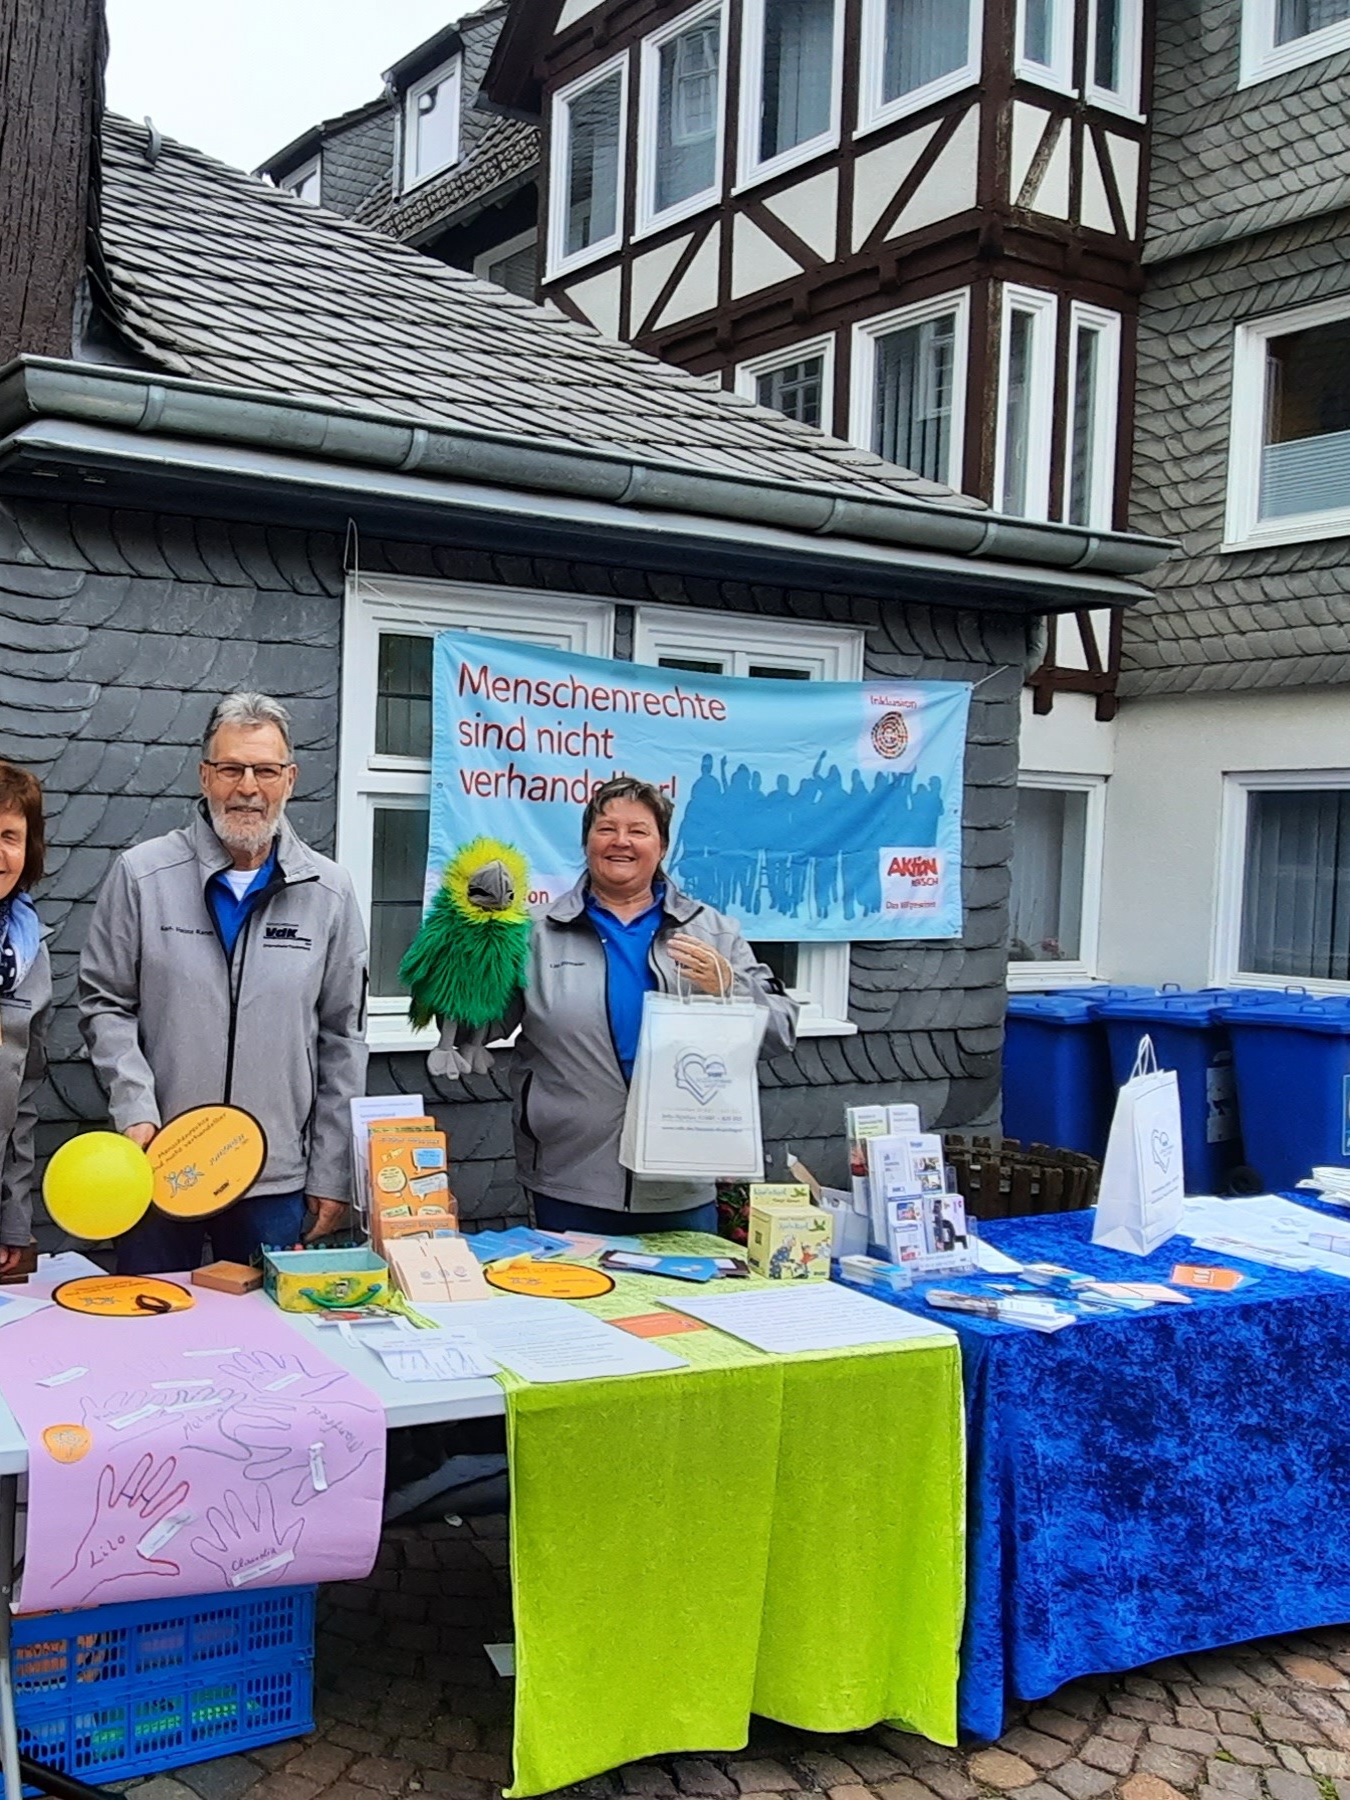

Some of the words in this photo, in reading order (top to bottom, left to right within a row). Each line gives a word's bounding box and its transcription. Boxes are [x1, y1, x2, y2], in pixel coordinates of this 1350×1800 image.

[458, 662, 727, 721] Menschenrechte
[458, 711, 526, 752] sind
[537, 720, 614, 759] nicht
[266, 927, 298, 938] VdK
[90, 1535, 125, 1569] Lilo
